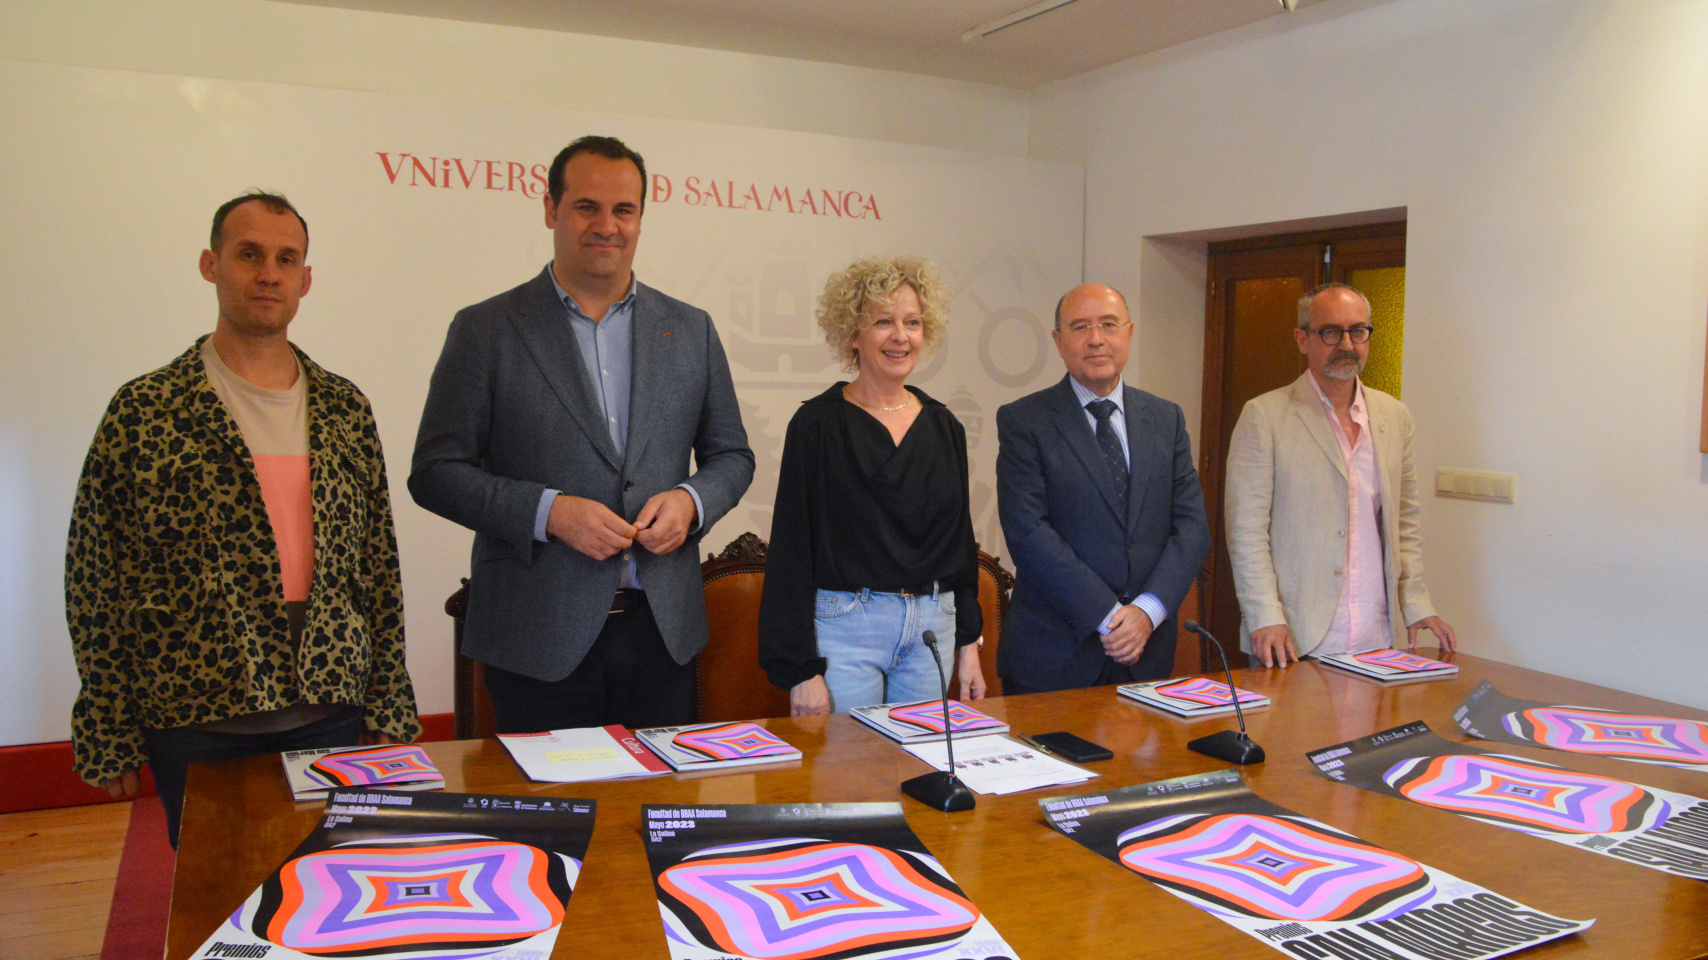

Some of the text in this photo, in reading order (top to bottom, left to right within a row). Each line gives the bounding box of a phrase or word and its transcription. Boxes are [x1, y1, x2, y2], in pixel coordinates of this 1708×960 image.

[375, 151, 548, 200] VNiVERS
[684, 176, 882, 220] SALAMANCA
[621, 737, 645, 754] Cultura
[334, 792, 359, 803] Facultad
[358, 793, 366, 804] de
[381, 794, 413, 805] Salamanca
[346, 805, 378, 815] 2023
[648, 809, 672, 819] Facultad
[672, 809, 680, 819] de
[695, 809, 727, 819] Salamanca
[1063, 808, 1090, 820] 2023
[648, 820, 696, 830] Mayo 2023
[203, 941, 272, 959] Premios
